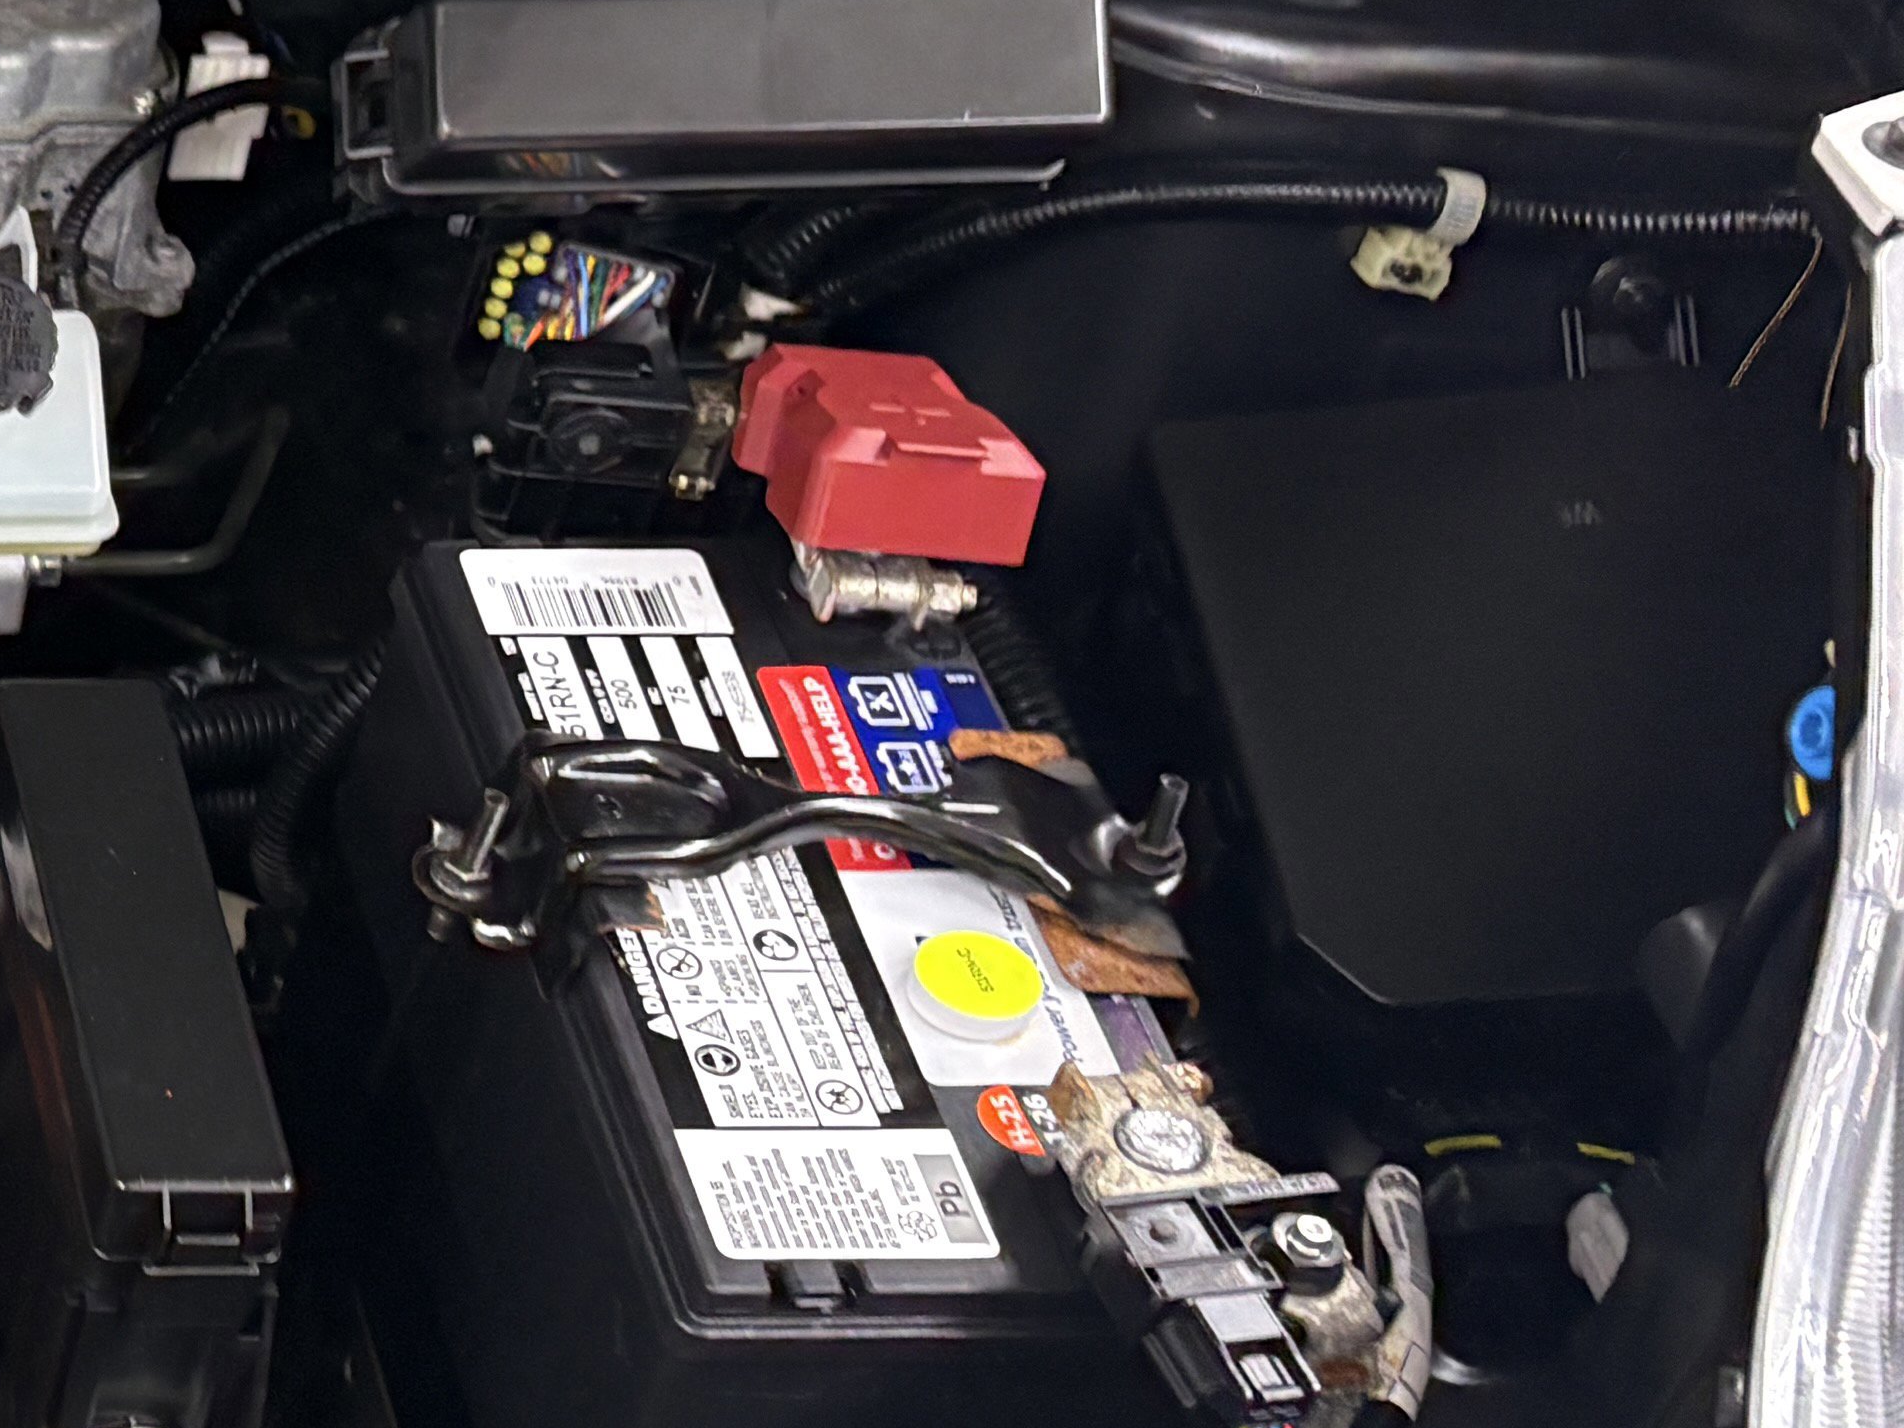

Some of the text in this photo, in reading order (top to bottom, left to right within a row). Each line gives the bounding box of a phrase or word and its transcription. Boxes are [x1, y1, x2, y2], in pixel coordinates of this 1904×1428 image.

[610, 679, 637, 710] 500
[671, 685, 690, 705] 75
[1044, 1008, 1084, 1063] Power
[989, 1094, 1037, 1149] H-25
[934, 1180, 971, 1219] Pb
